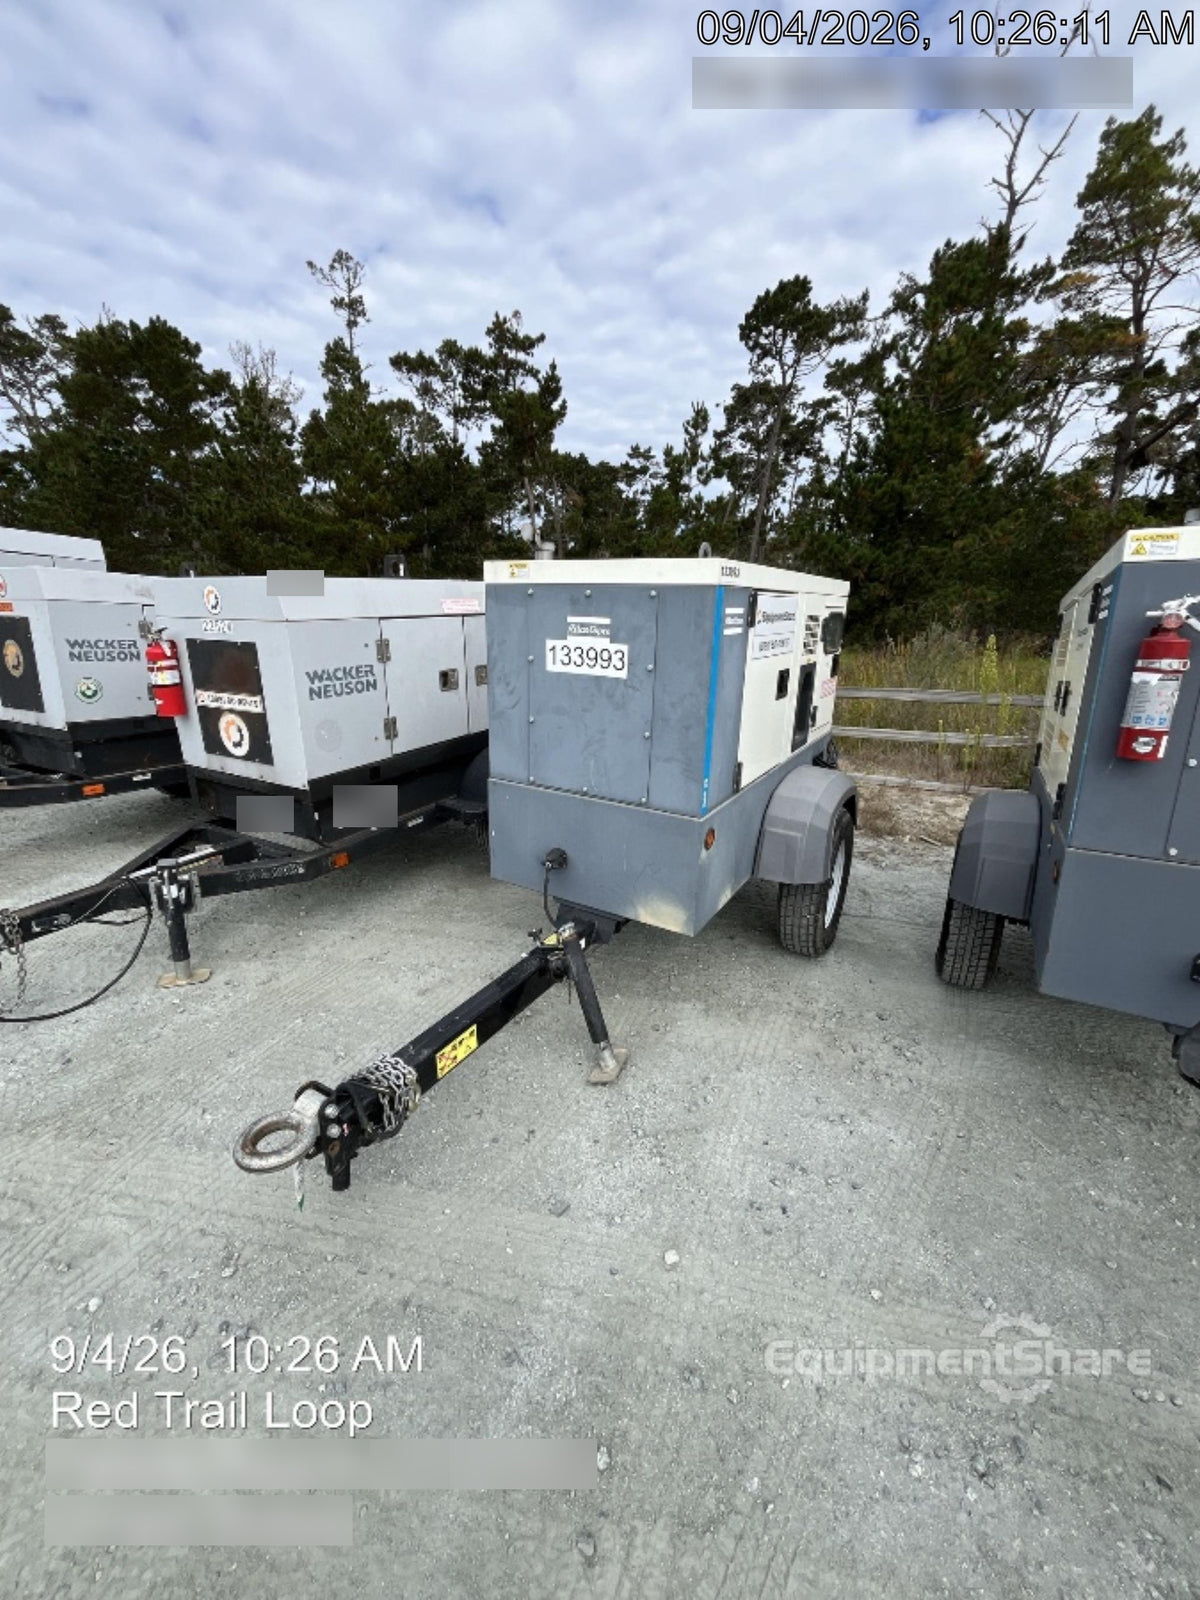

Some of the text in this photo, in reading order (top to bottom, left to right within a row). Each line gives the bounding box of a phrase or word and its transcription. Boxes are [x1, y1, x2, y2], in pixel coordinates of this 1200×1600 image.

[64, 638, 139, 650] WACKER
[68, 650, 141, 662] NEUSON
[548, 644, 626, 671] 133993
[305, 664, 376, 685] WACKER
[308, 678, 378, 701] NEUSON
